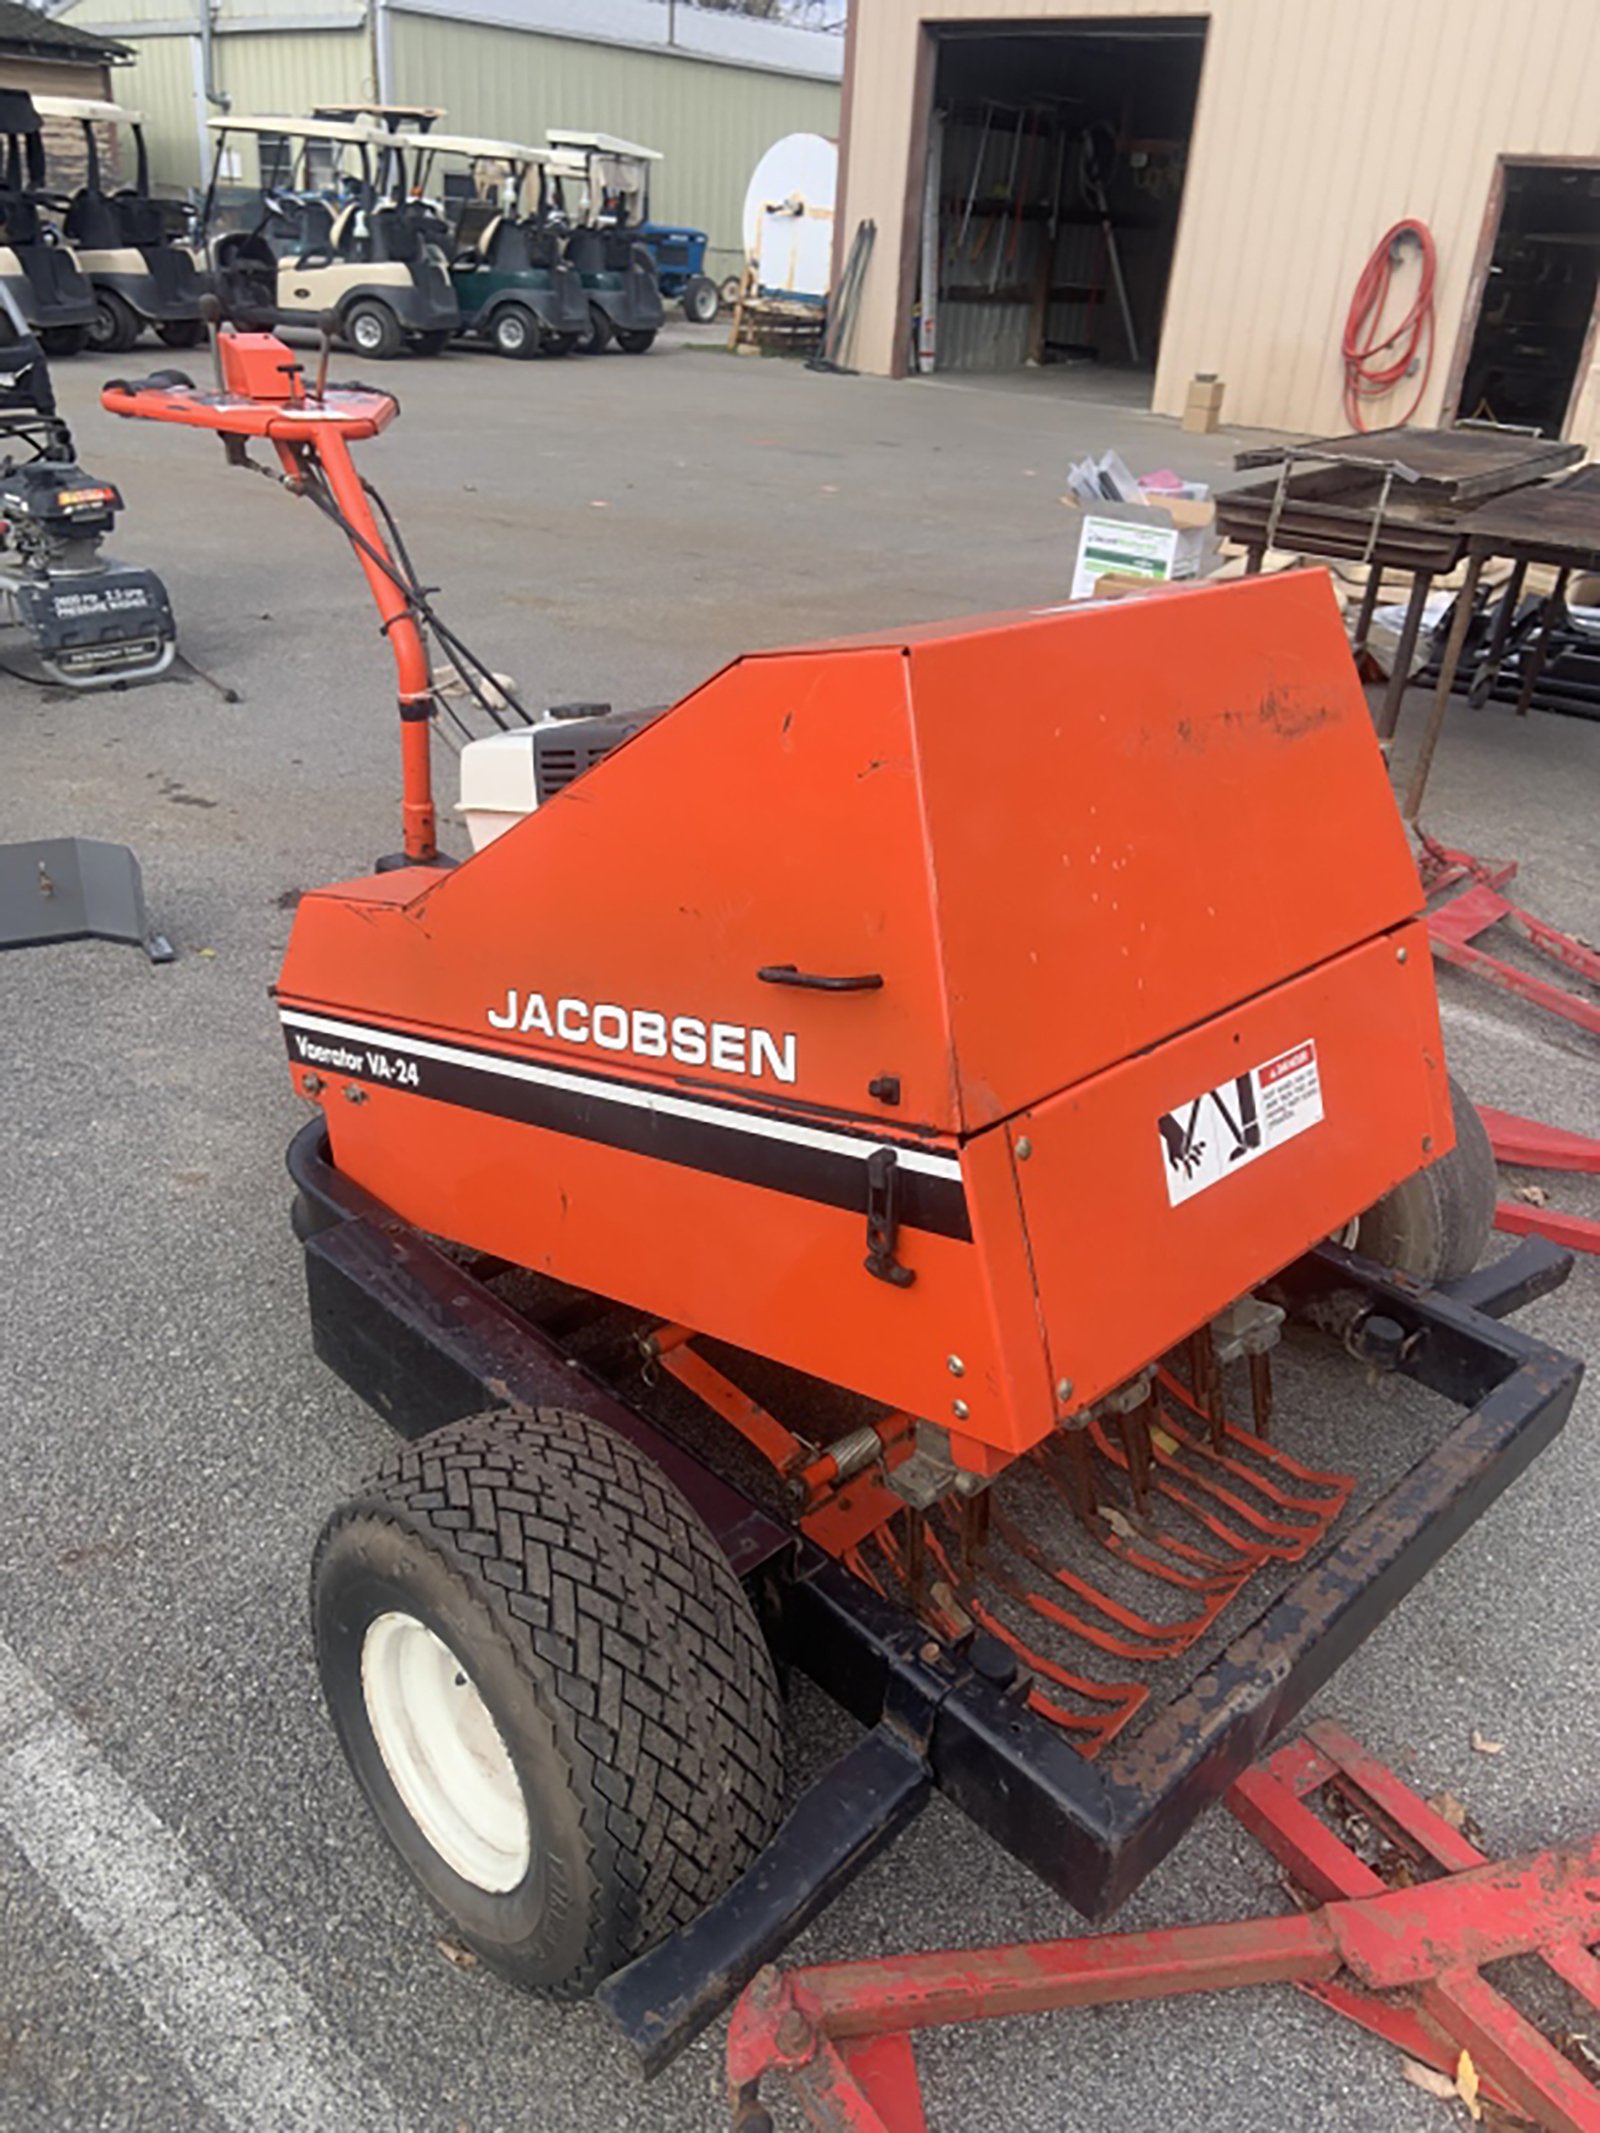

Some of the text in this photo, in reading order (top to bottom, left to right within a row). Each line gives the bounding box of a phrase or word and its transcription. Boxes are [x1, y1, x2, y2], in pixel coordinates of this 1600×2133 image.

[295, 1034, 420, 1087] Vaerator VA-24
[488, 990, 796, 1082] JACOBSEN
